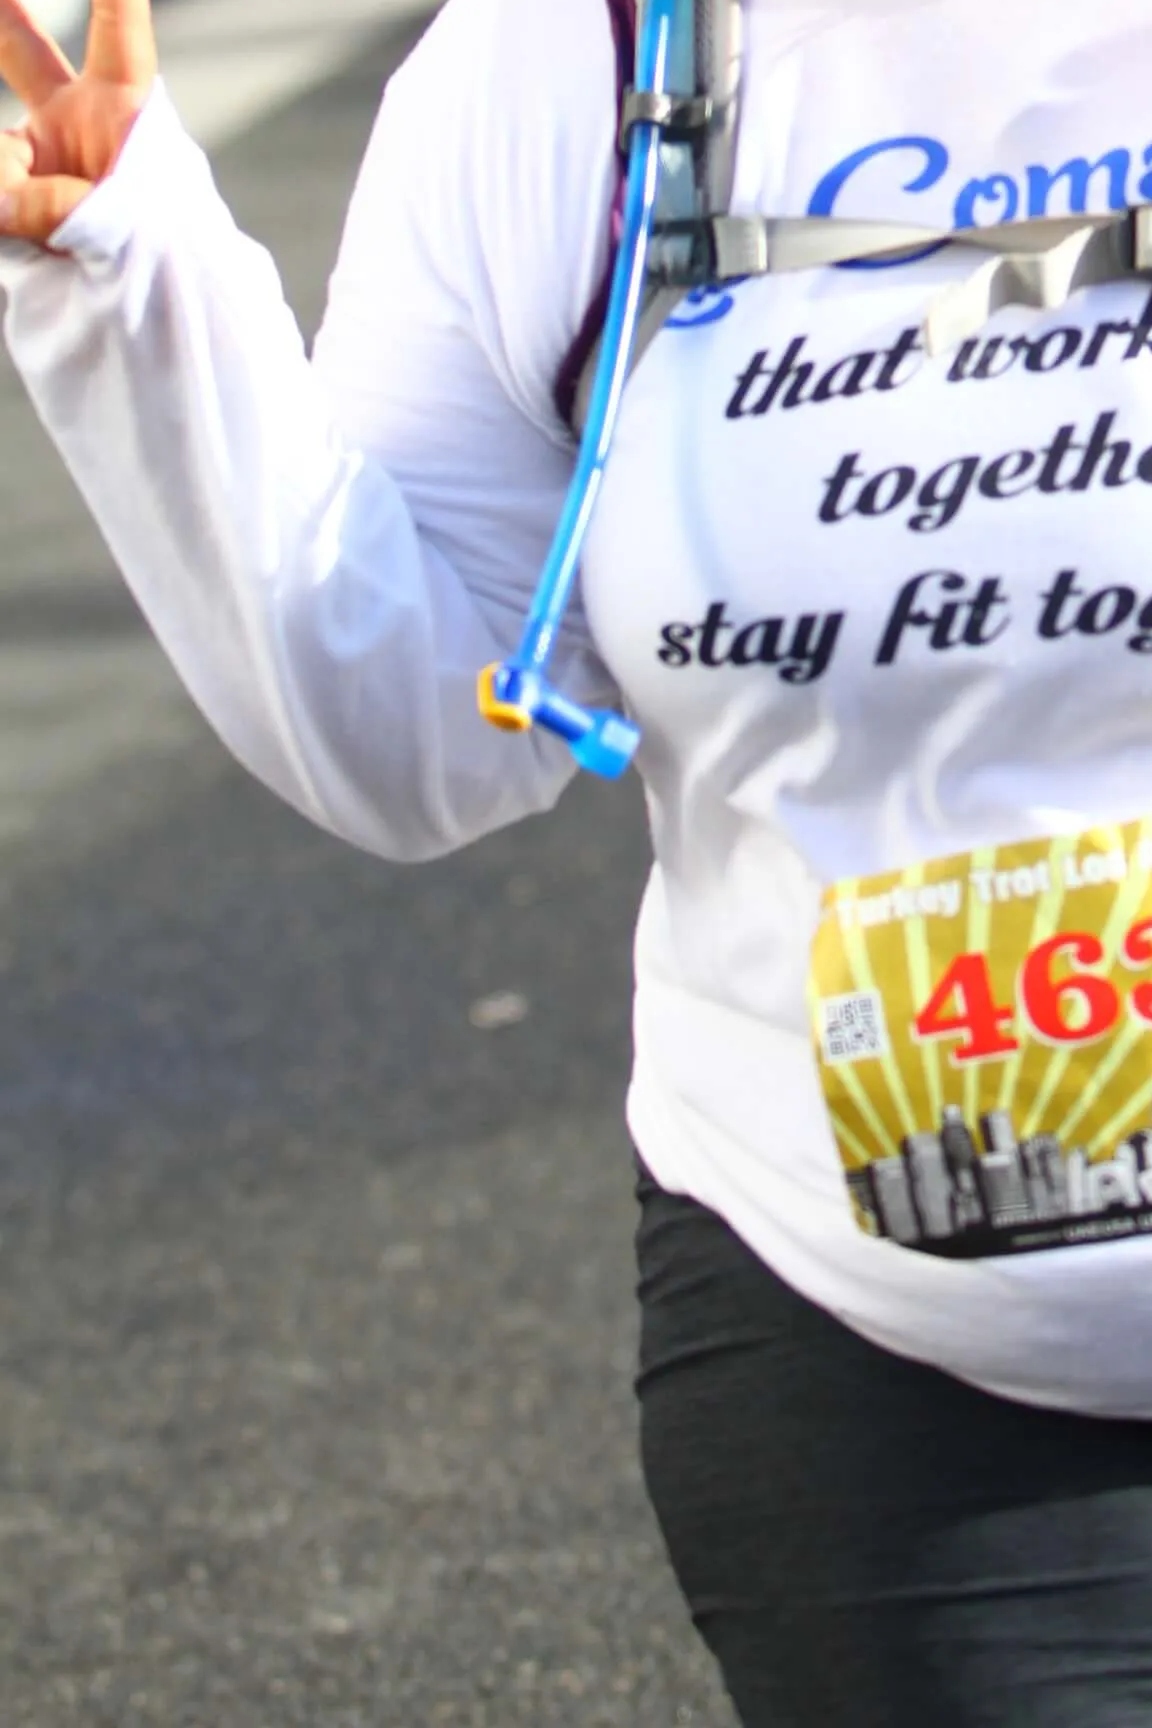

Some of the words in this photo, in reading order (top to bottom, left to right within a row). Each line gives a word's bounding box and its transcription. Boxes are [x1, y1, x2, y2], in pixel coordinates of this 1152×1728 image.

[724, 326, 925, 419] that
[656, 600, 841, 686] stay
[873, 570, 1009, 668] fit
[836, 877, 961, 928] Turkey
[970, 862, 1051, 904] Trot
[1063, 847, 1129, 887] Los
